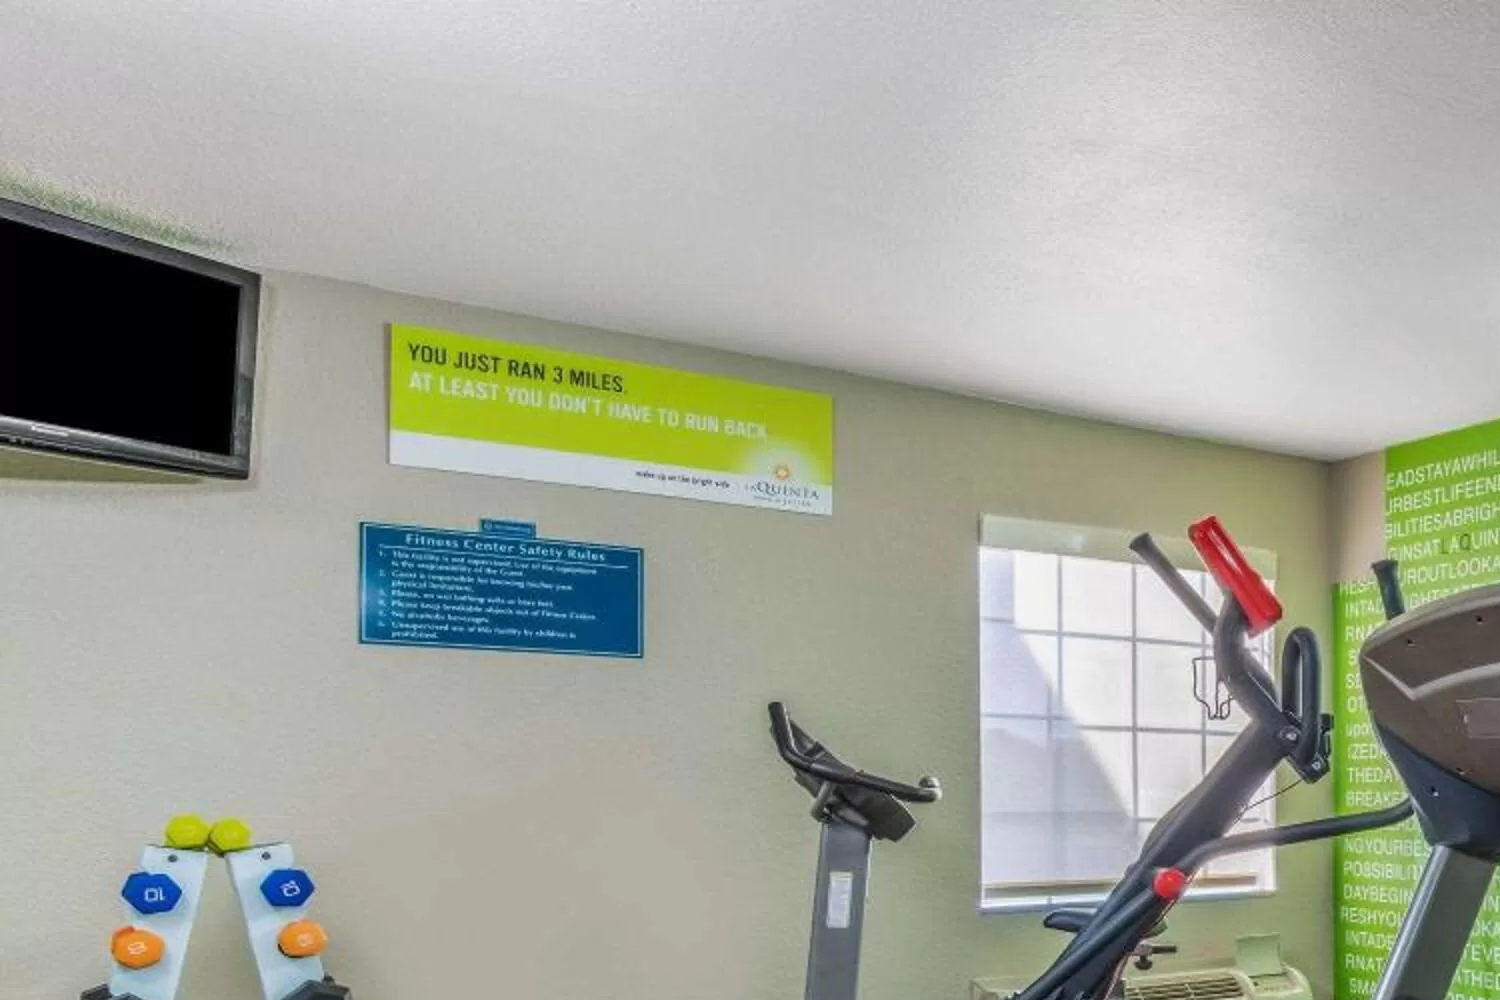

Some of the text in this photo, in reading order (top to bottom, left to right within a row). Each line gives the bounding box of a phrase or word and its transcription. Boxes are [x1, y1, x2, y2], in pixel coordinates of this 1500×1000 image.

[408, 341, 447, 366] YOU
[453, 351, 502, 374] JUST
[508, 359, 546, 381] RAN
[552, 367, 563, 383] 3
[409, 371, 432, 393] AT
[439, 375, 499, 402] LEAST
[505, 386, 545, 409] YOU
[608, 402, 652, 423] HAVE
[658, 408, 680, 427] TO
[686, 413, 719, 433] RUN
[405, 533, 606, 562] Fitness Center Safety Rules
